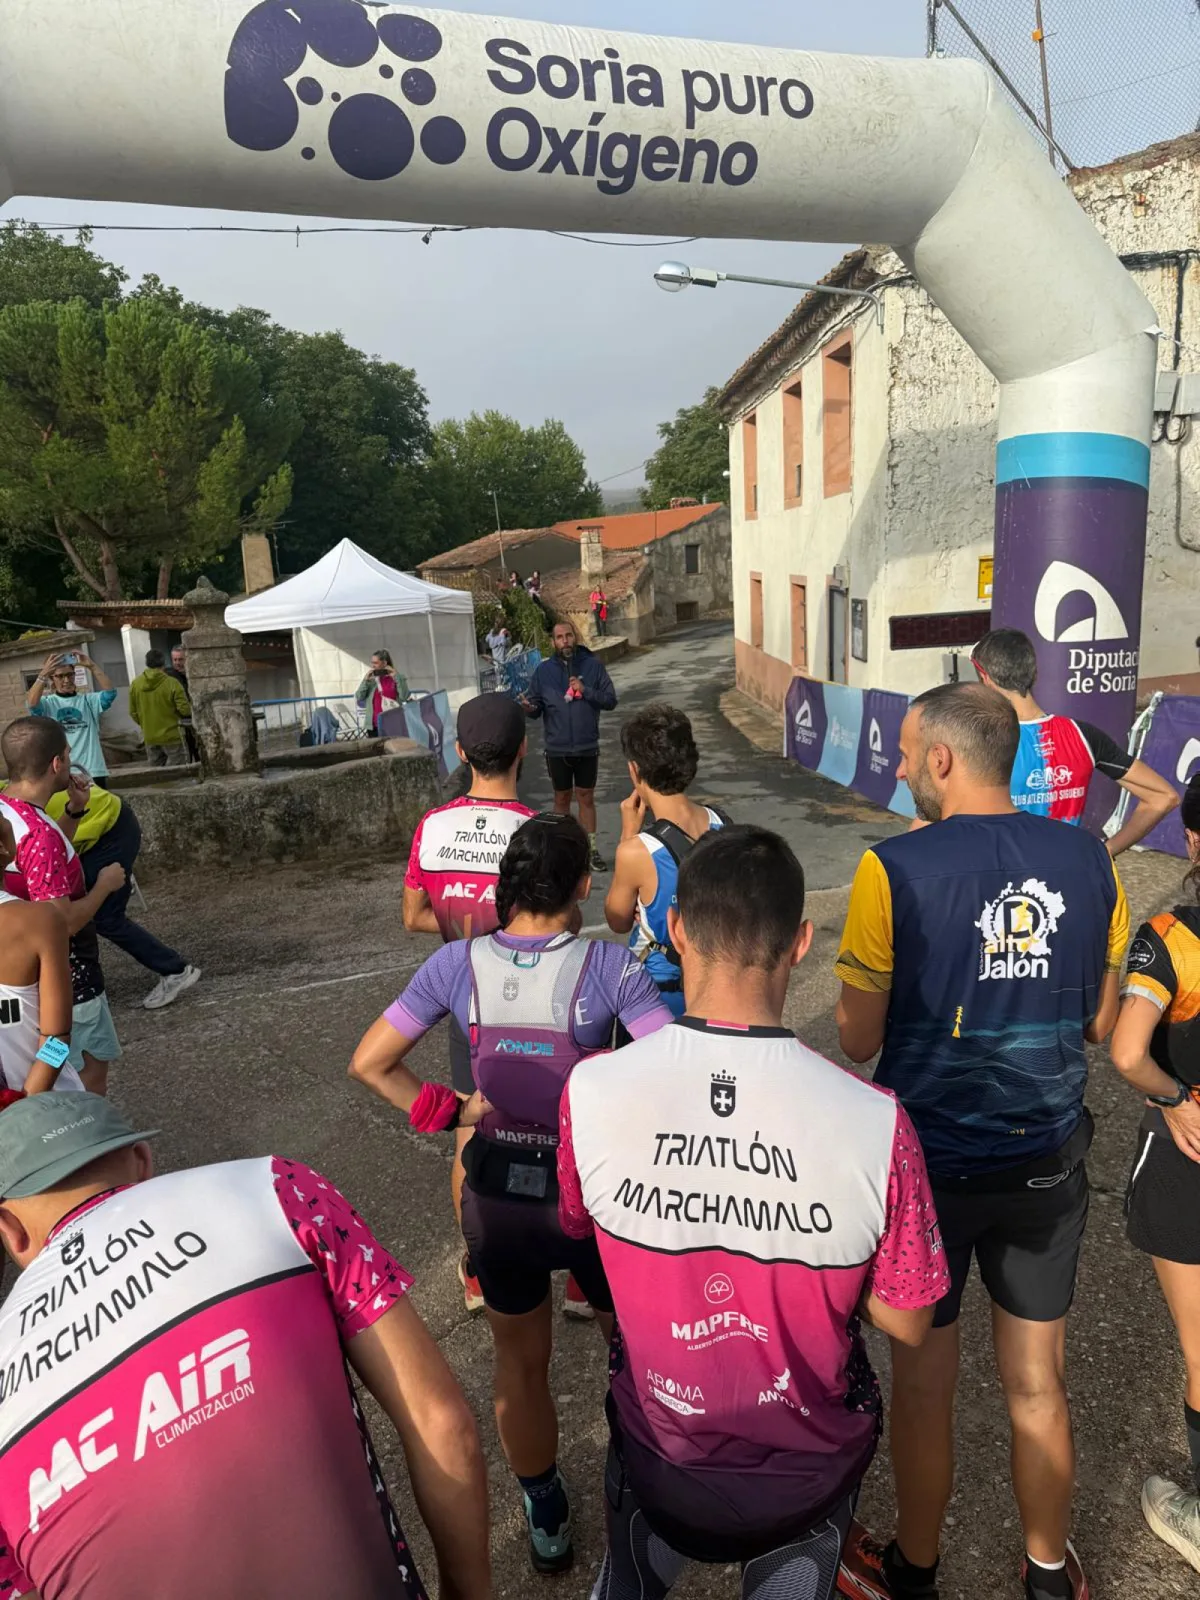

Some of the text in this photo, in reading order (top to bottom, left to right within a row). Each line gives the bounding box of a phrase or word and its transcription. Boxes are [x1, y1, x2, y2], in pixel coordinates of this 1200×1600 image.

[485, 37, 815, 130] Soria puro
[486, 106, 759, 196] Oxígeno
[1068, 648, 1138, 676] Diputac
[1066, 670, 1137, 694] de Soria
[454, 830, 508, 846] TRIATLÓN
[441, 881, 478, 900] MC
[978, 950, 1050, 982] Jalón
[494, 1127, 559, 1146] MAPFRE
[653, 1130, 798, 1183] TRIATLÓN
[613, 1177, 833, 1234] MARCHAMALO
[19, 1219, 155, 1337] TRIATLÓN
[671, 1311, 769, 1343] MAPFRE
[687, 1340, 713, 1351] ALBERTO
[647, 1368, 705, 1402] AROMA
[155, 1380, 255, 1449] CLIMATIZACIÓN
[28, 1406, 119, 1535] MC
